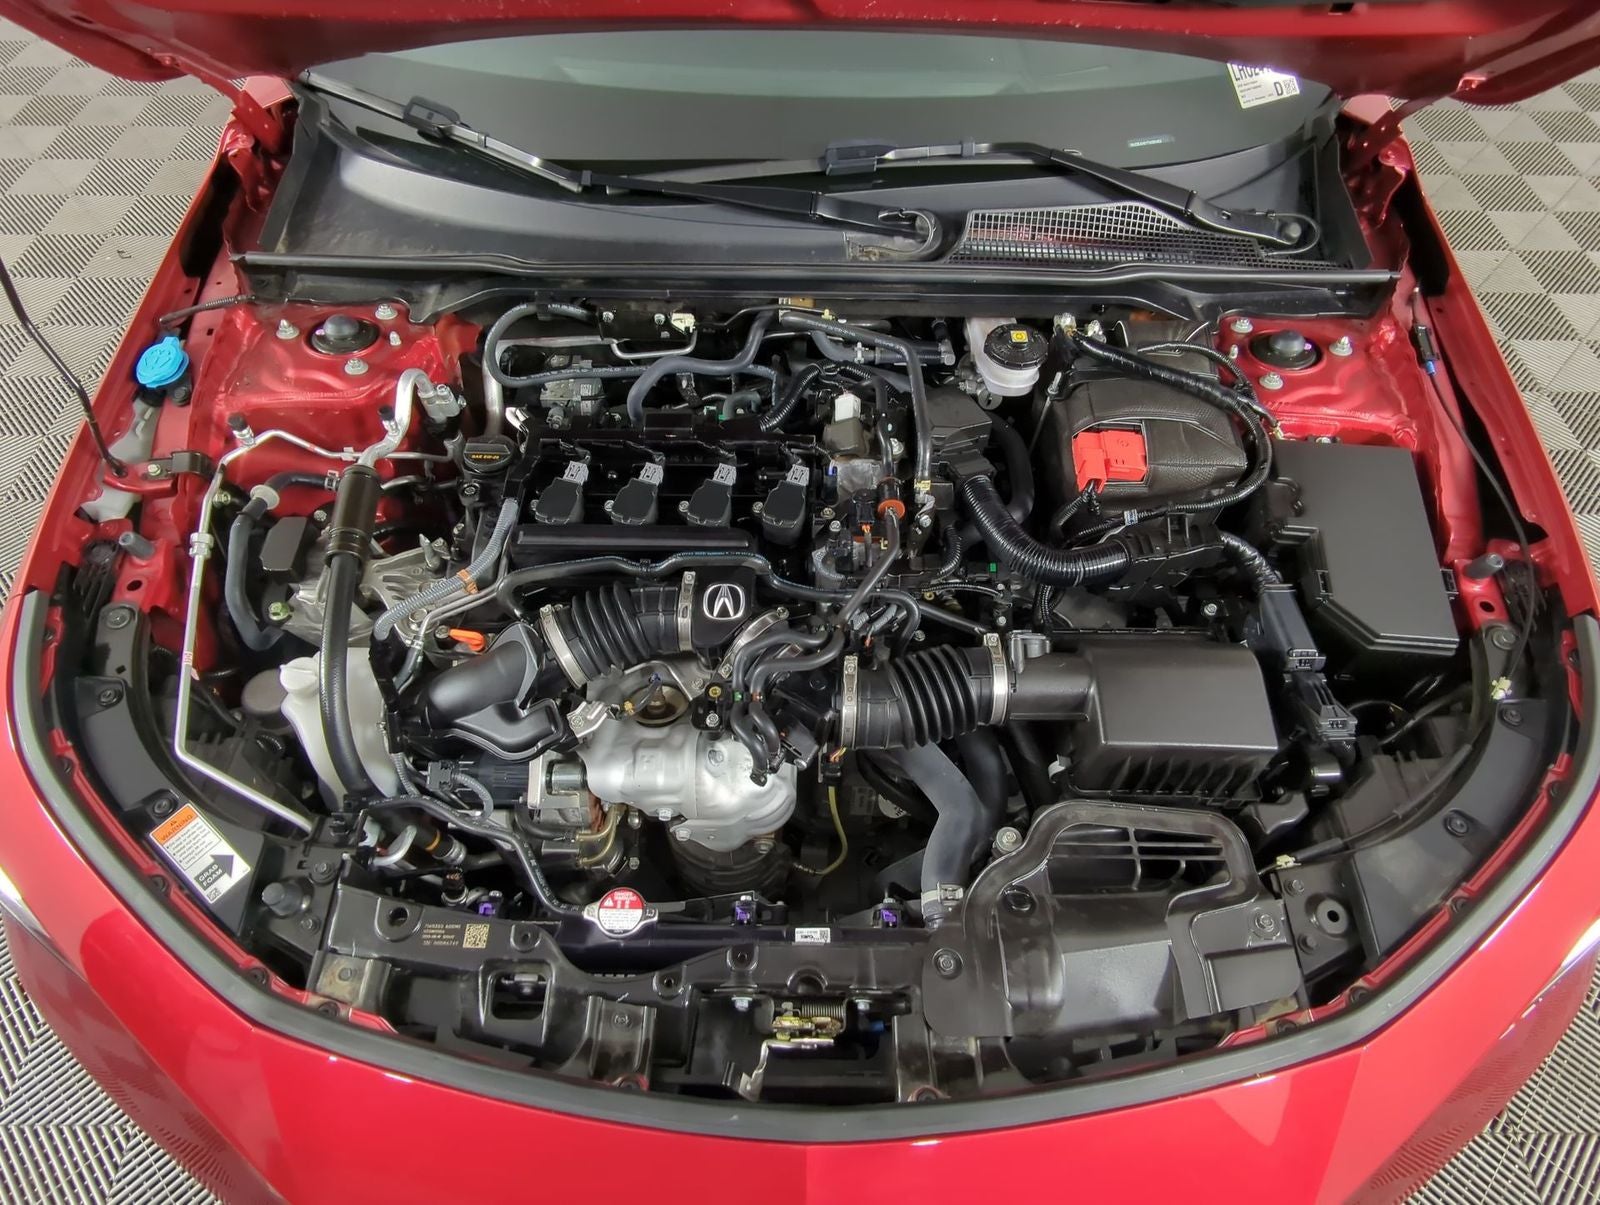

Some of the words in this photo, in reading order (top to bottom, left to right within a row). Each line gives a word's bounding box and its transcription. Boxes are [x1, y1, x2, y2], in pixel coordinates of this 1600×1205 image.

[1273, 81, 1284, 96] D
[162, 814, 193, 841] WARNING
[199, 864, 218, 882] GRAB
[203, 869, 222, 887] FOAM
